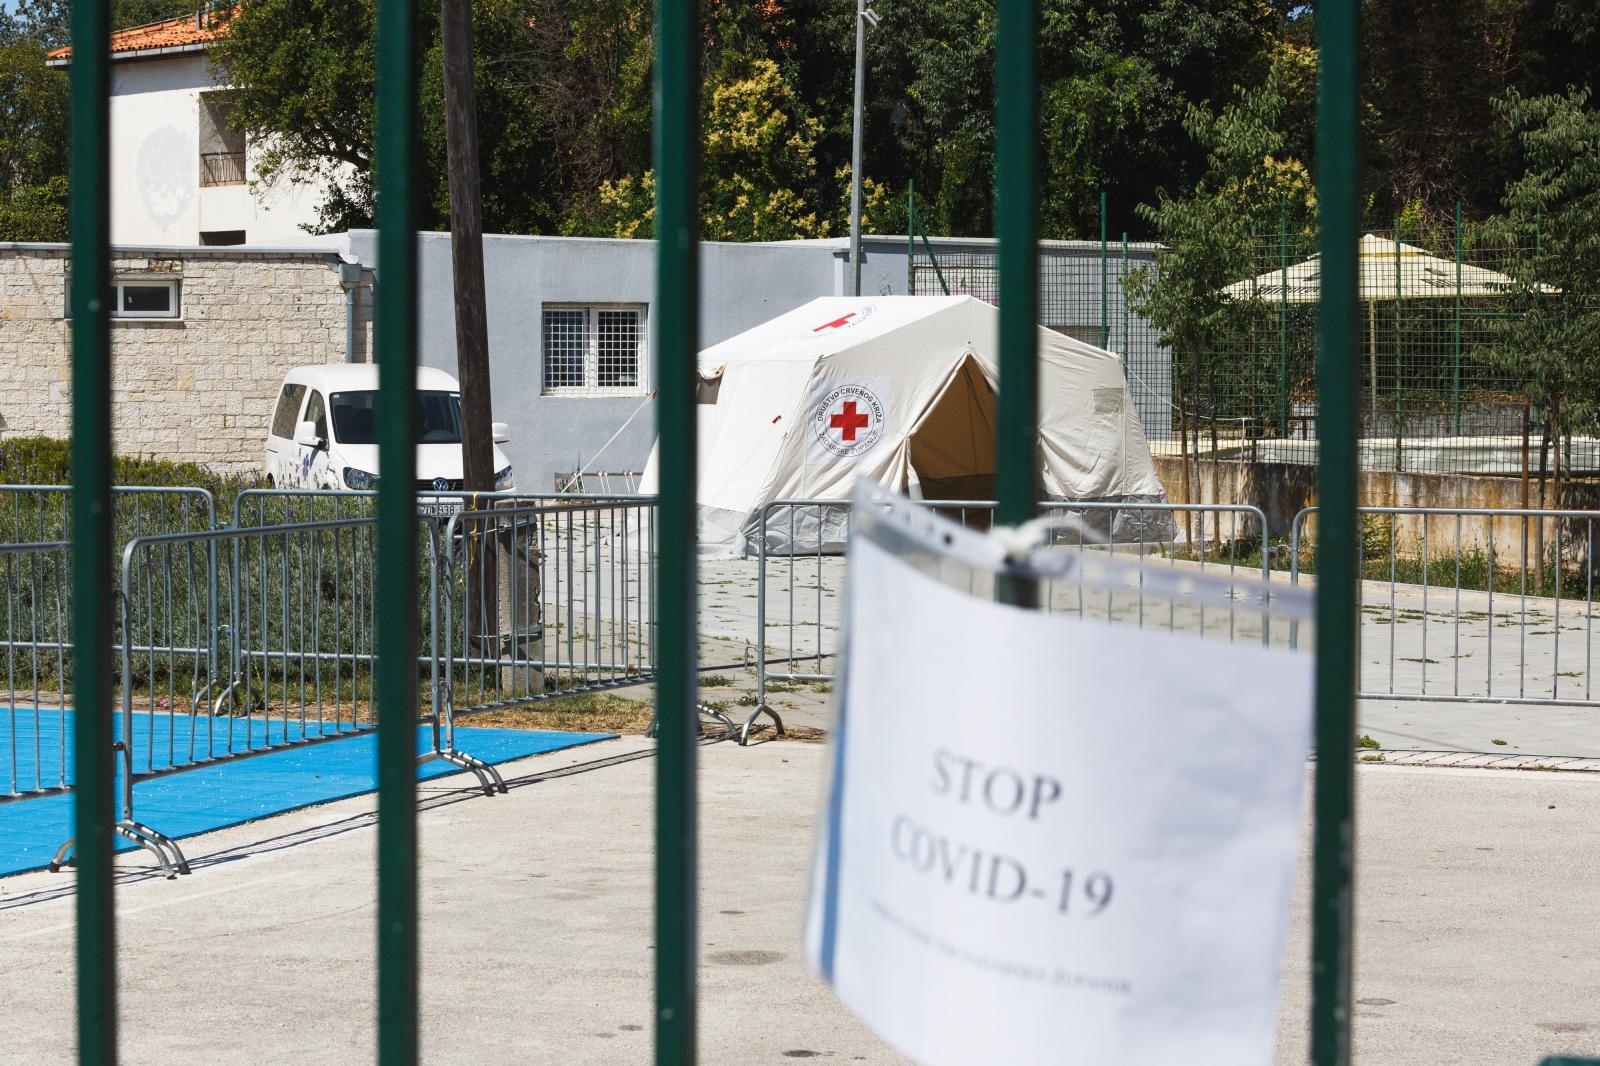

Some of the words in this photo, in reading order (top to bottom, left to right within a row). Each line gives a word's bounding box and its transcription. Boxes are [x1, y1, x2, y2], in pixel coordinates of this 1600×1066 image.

[817, 391, 840, 422] DRUŠTVO
[840, 387, 874, 403] CRVENOG
[871, 401, 883, 424] KRIŽA
[931, 747, 1062, 819] STOP
[891, 813, 1115, 918] COVID-19
